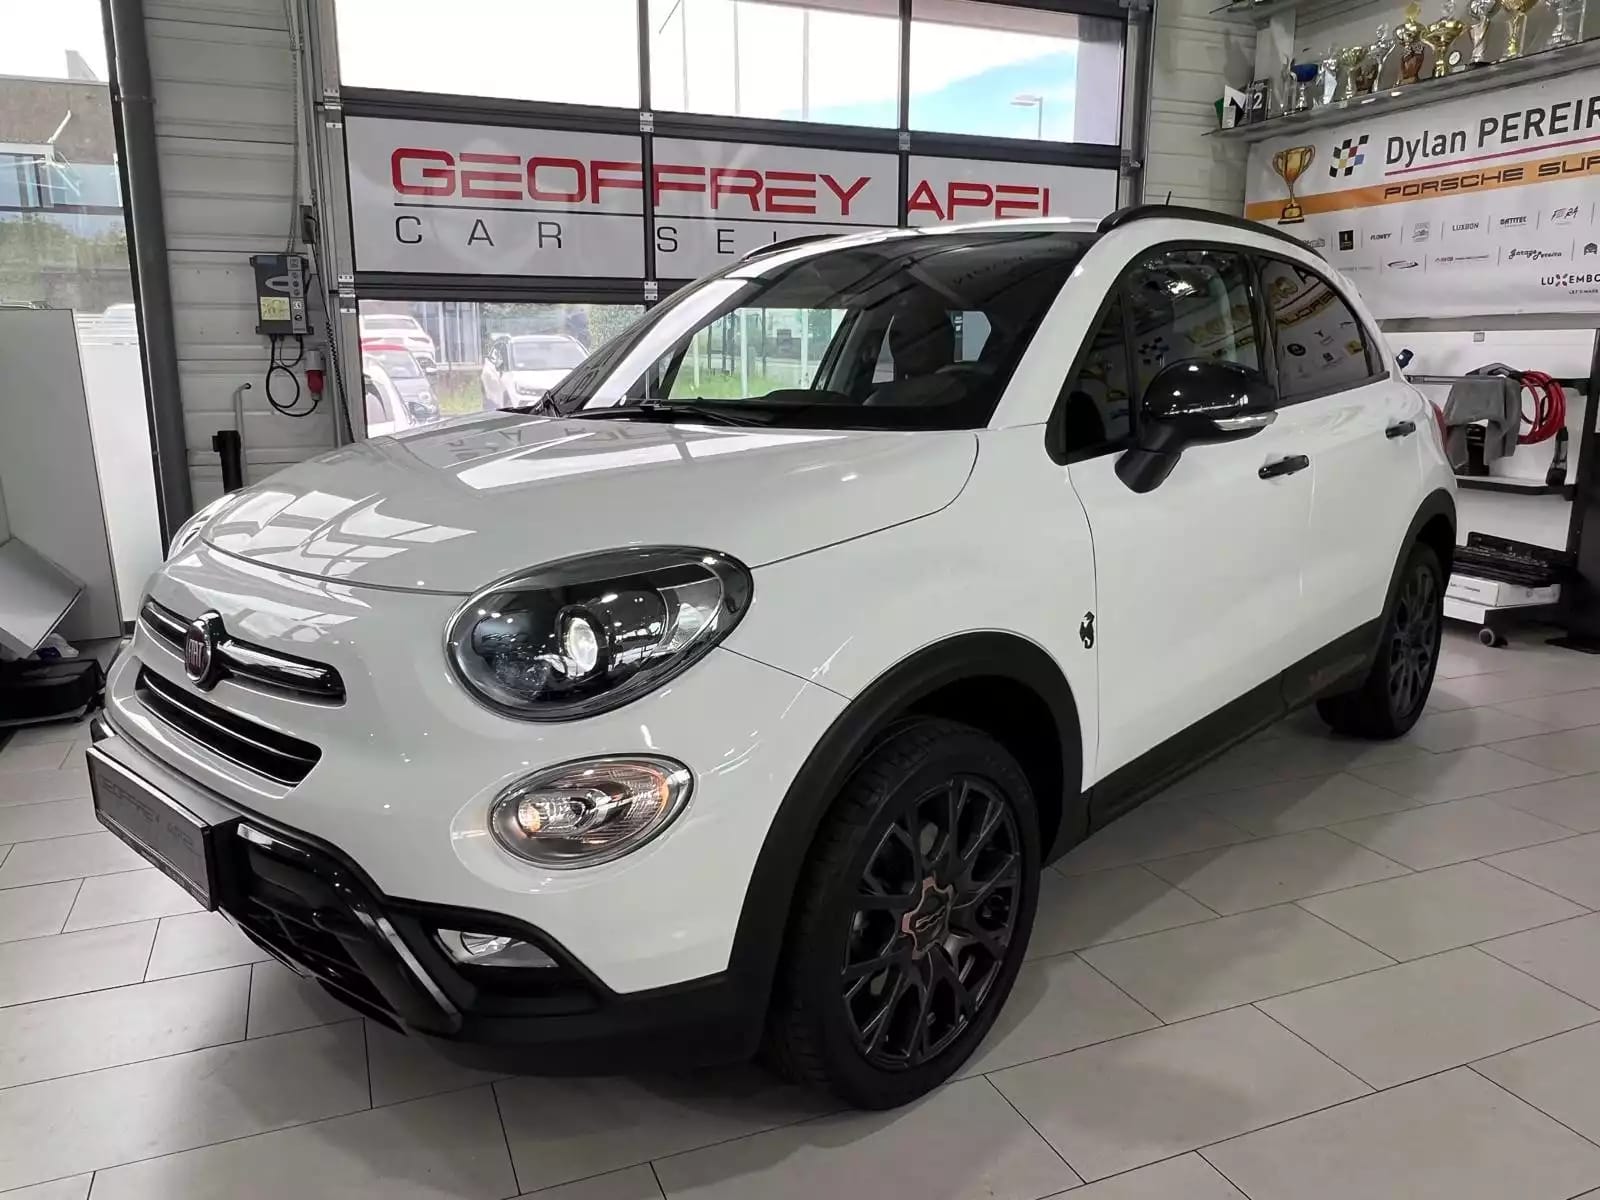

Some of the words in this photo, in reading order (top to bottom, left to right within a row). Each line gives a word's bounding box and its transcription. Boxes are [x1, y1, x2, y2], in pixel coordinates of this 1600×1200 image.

[1386, 129, 1467, 168] Dylan
[391, 147, 871, 216] GEOFFREY
[1384, 167, 1524, 199] PORSCHE
[395, 215, 562, 249] CAR
